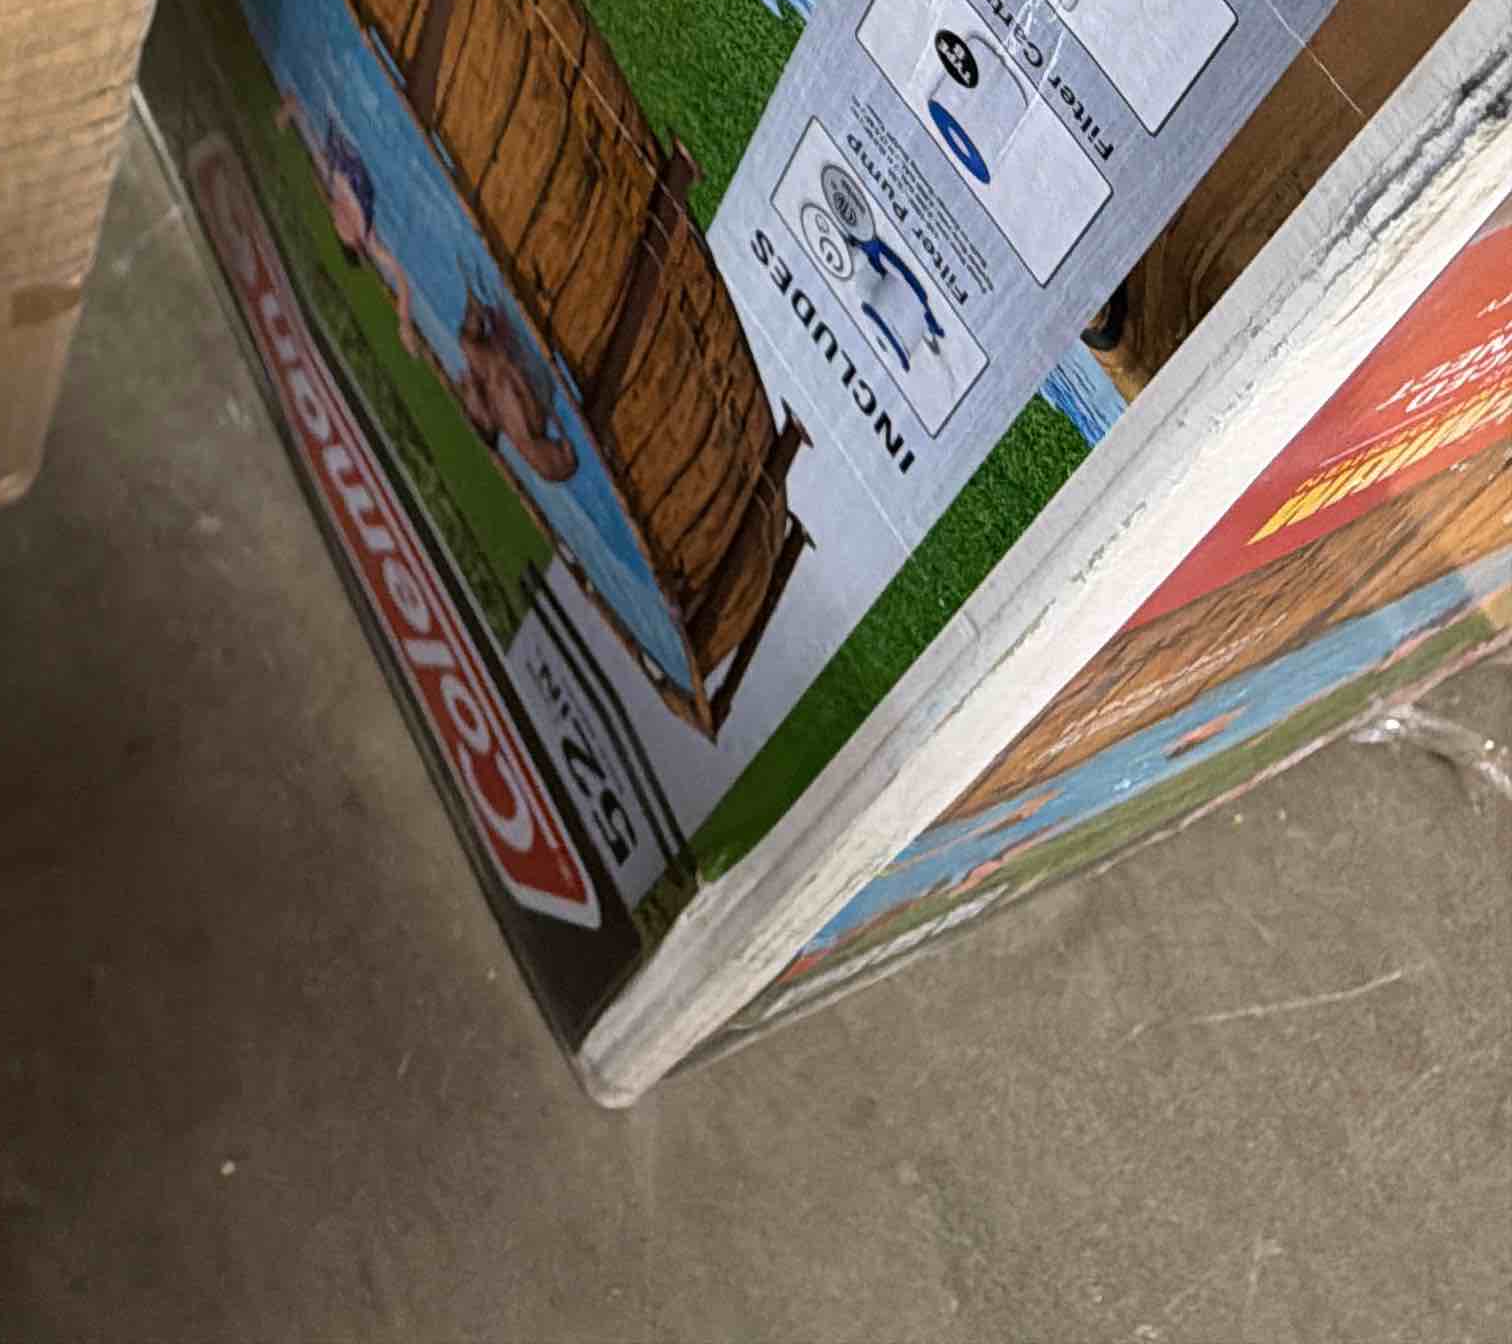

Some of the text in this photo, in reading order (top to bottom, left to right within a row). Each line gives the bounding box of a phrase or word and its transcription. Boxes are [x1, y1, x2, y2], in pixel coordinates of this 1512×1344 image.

[1047, 73, 1118, 164] Filter
[845, 132, 911, 225] Pump
[911, 223, 971, 307] Filter
[749, 228, 918, 476] INCLUDES
[260, 289, 536, 855] Coleman
